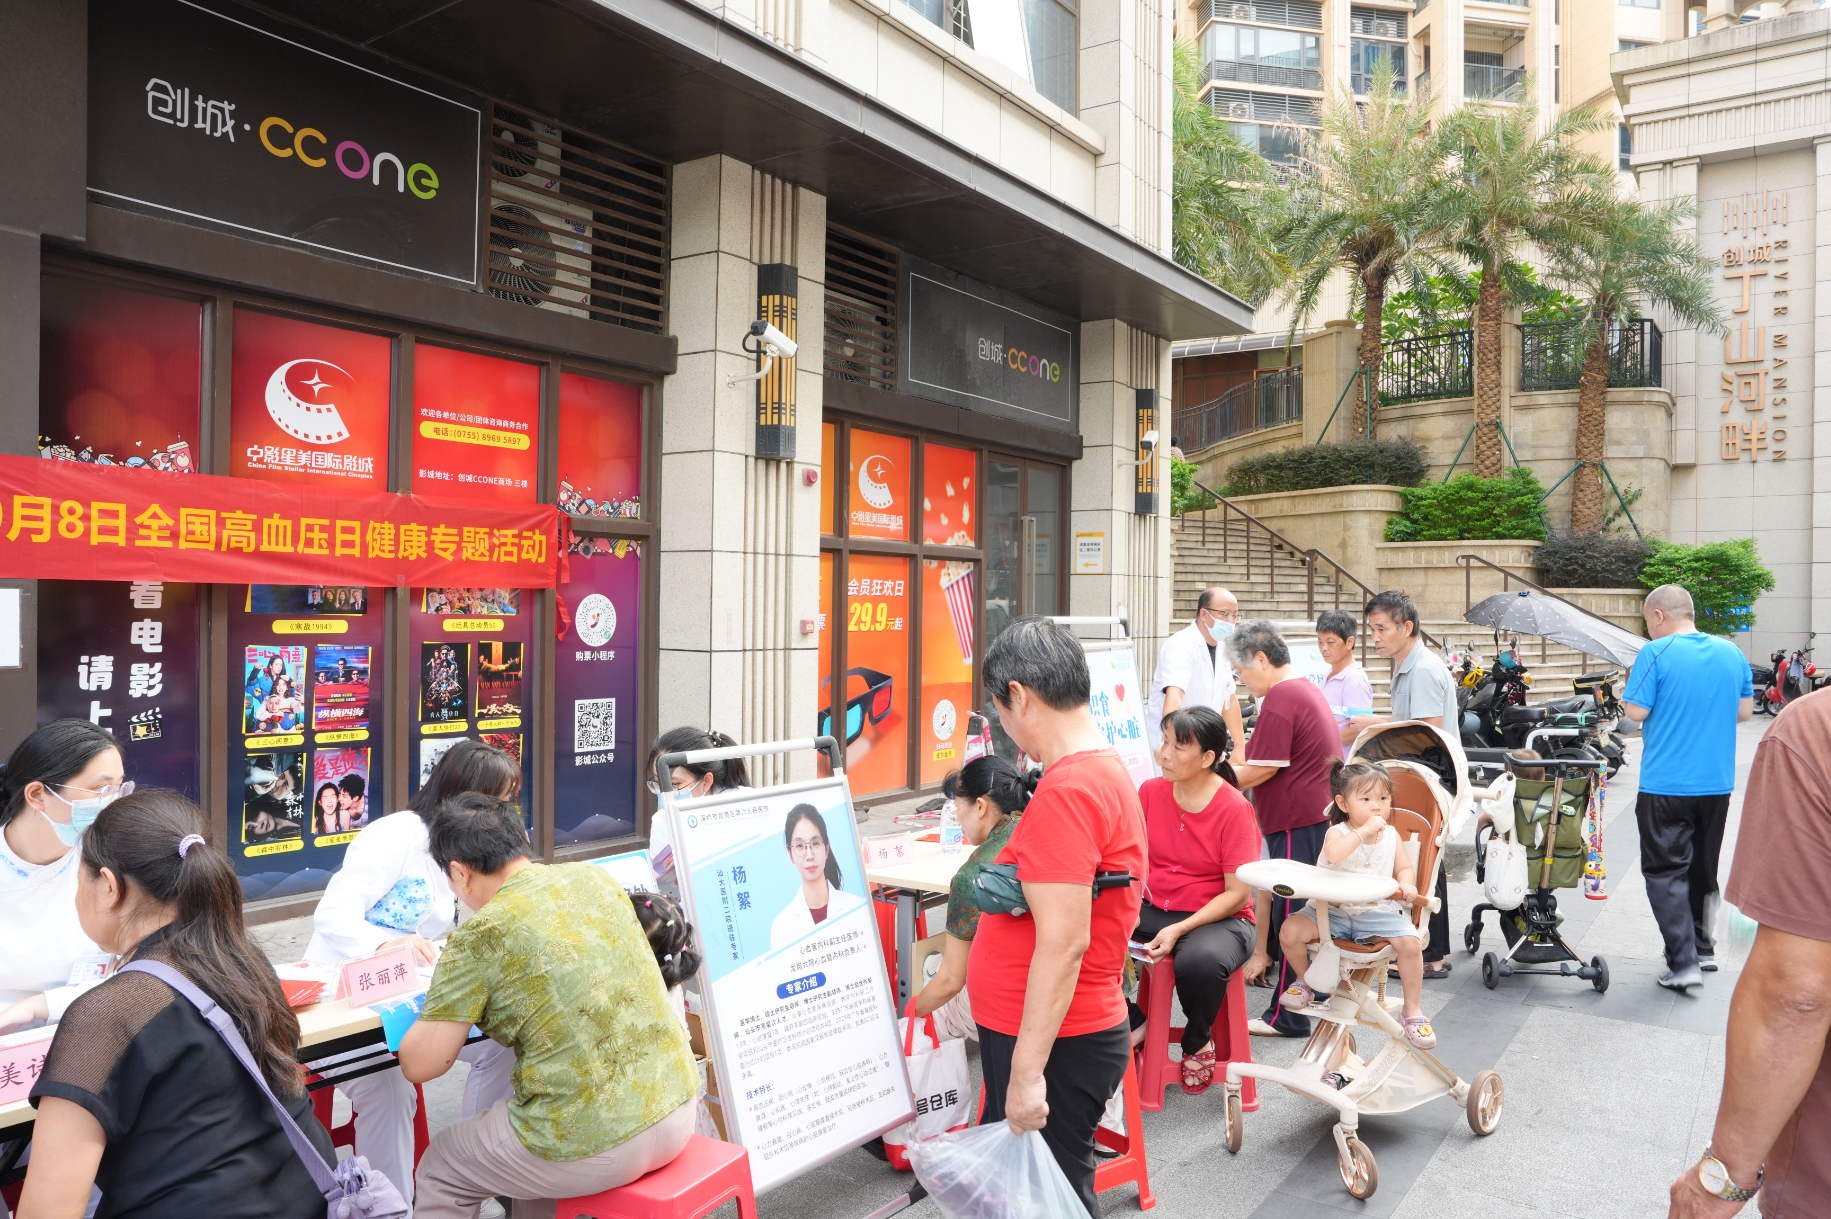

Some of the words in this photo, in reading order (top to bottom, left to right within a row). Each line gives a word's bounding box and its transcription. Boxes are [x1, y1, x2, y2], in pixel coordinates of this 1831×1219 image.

[1722, 242, 1771, 267] 创城
[1774, 239, 1789, 316] RIVER
[1721, 270, 1769, 463] 丁山河畔
[1773, 333, 1788, 461] MANSION
[420, 408, 528, 431] 欢迎各单位/公司/团体咨询商务合作
[482, 434, 500, 443] 8969
[503, 436, 521, 445] 5897
[247, 445, 373, 474] 中影星美国际影城
[247, 461, 267, 469] China
[268, 463, 282, 471] Film
[284, 465, 305, 473] Stellar
[307, 467, 346, 477] International
[348, 471, 373, 479] Cineplex
[513, 479, 528, 488] 三楼
[848, 578, 904, 597] 会员狂欢日
[848, 602, 903, 632] 29.9元起
[129, 581, 164, 698] 看电影
[575, 650, 615, 662] 购票小程序
[575, 753, 615, 766] 影城公众号
[731, 865, 752, 911] 杨絮
[798, 930, 858, 955] 心血管内科副主任医师
[789, 943, 861, 973] 龙岗六院心血管内科负责人
[358, 962, 408, 991] 张丽萍
[785, 975, 817, 995] 专家介绍
